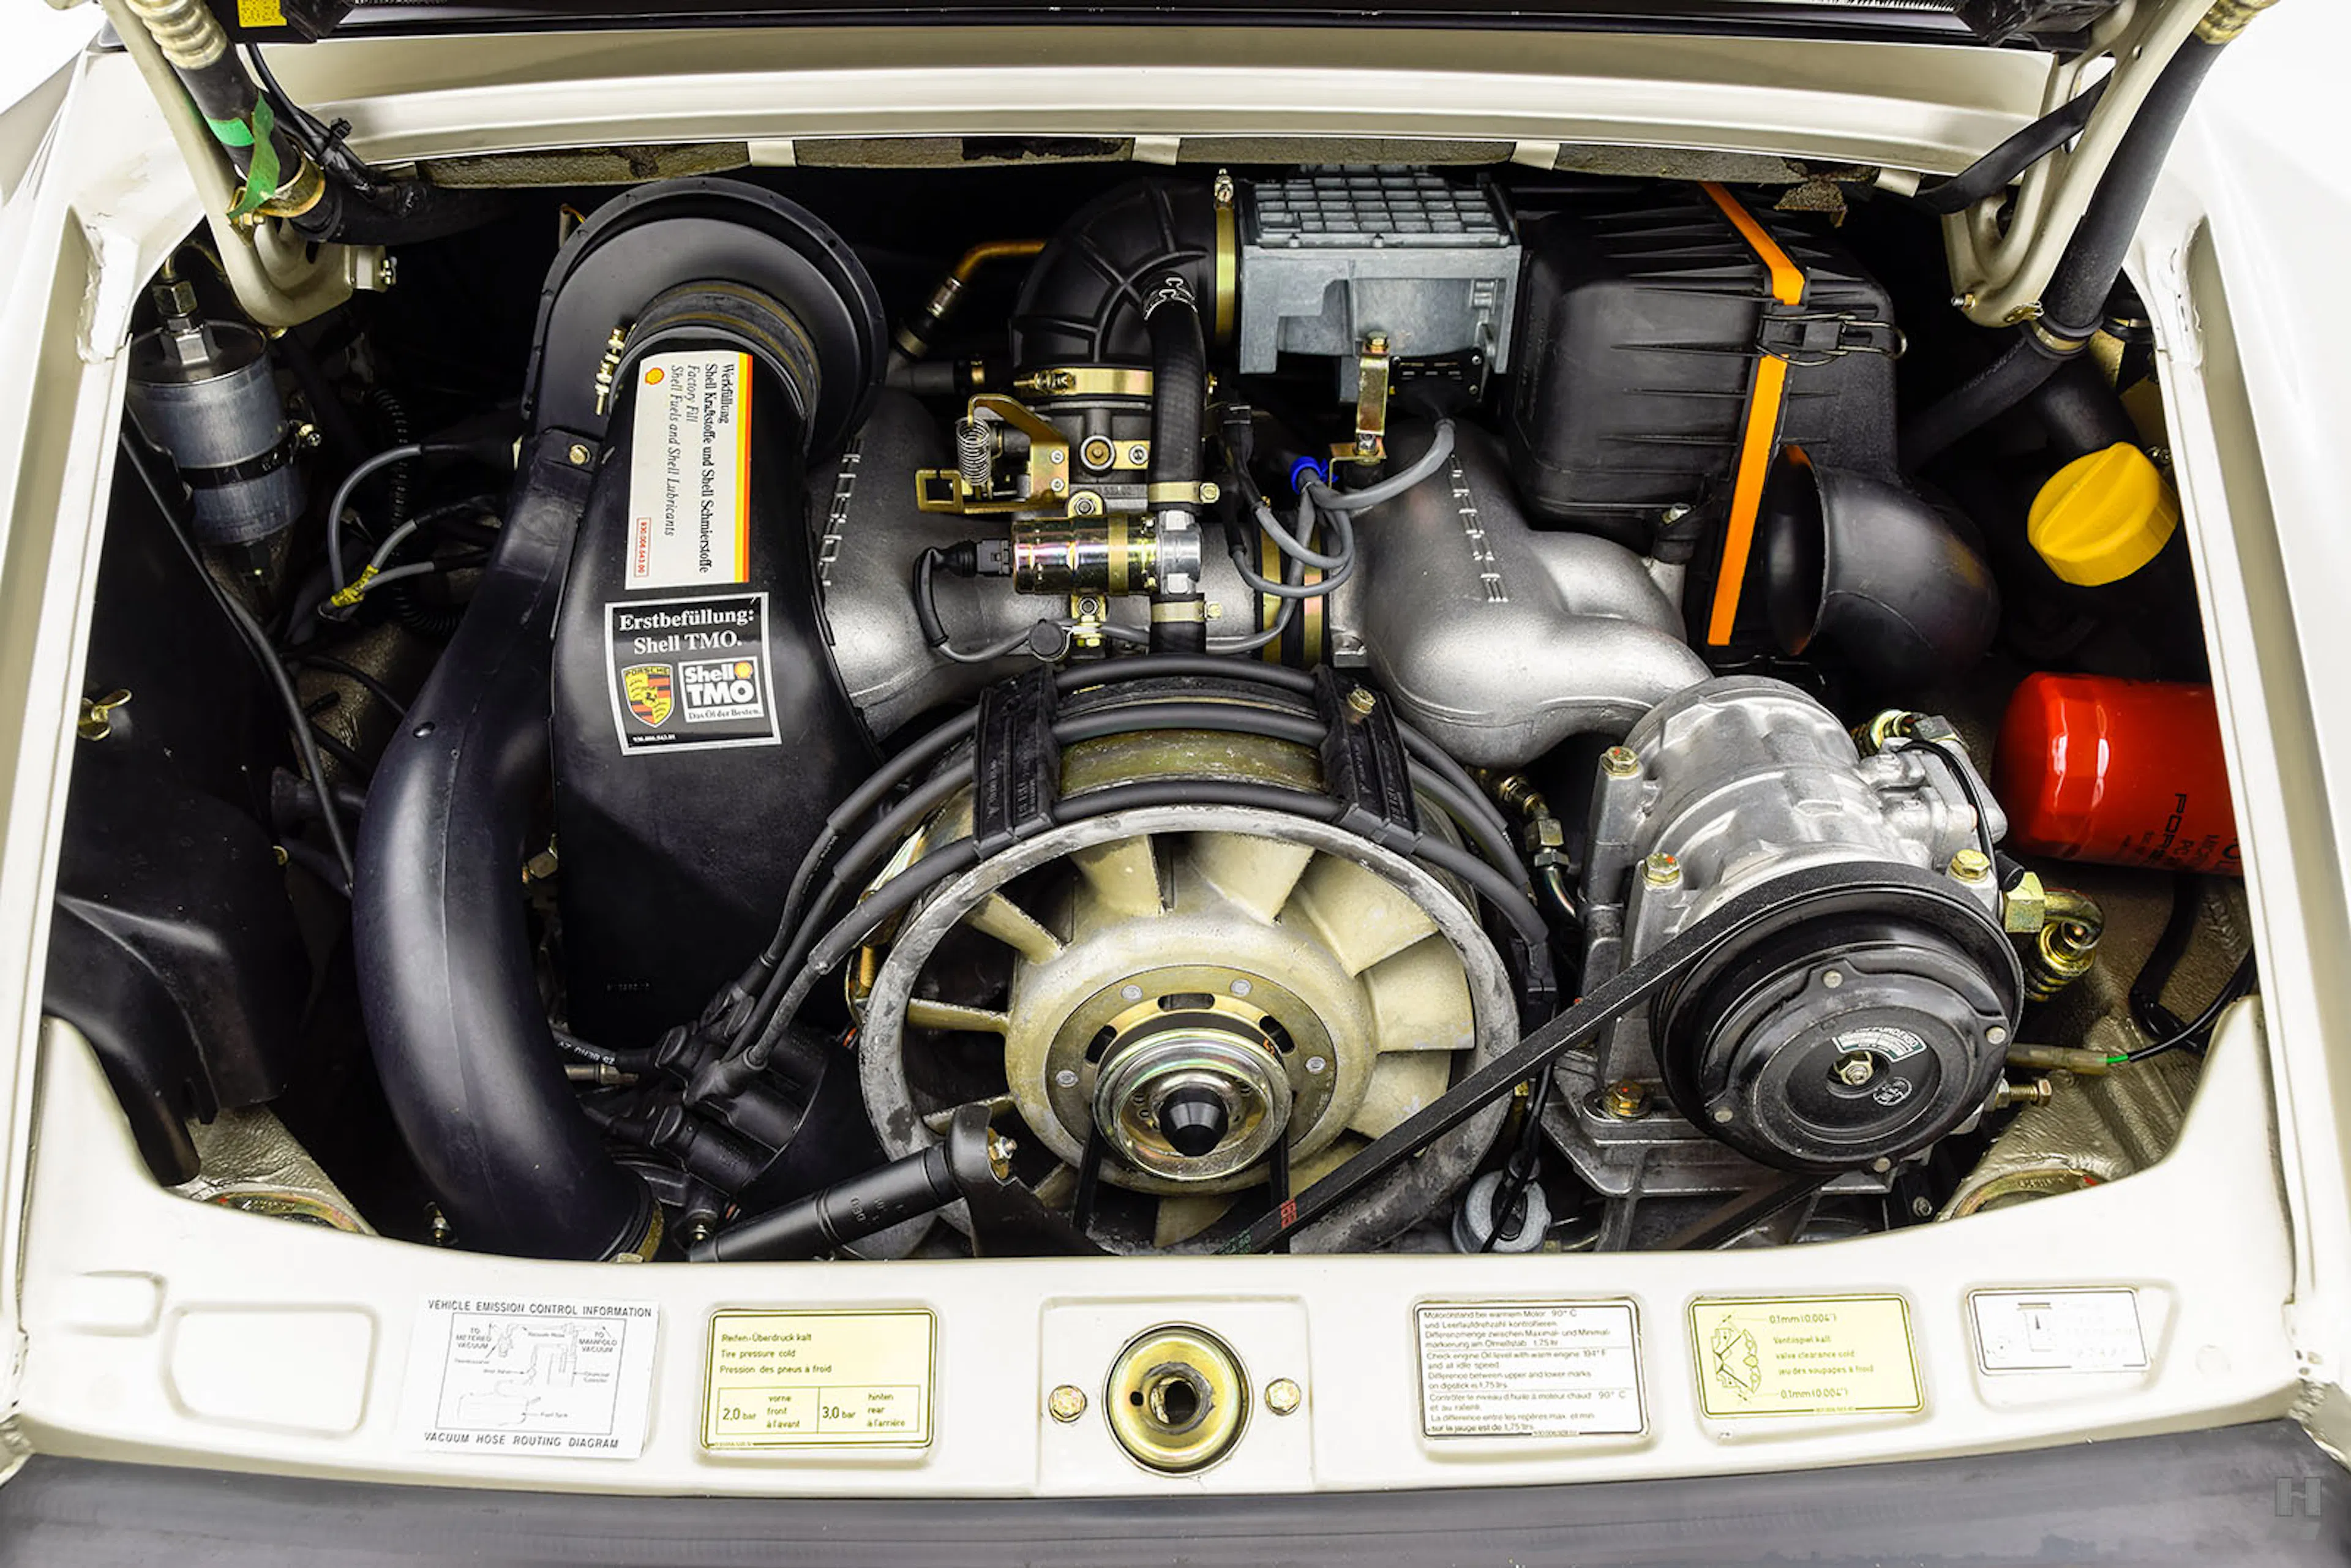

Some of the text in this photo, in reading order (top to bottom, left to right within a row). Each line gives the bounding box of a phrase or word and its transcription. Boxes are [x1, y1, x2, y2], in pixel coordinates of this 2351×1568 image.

[686, 365, 700, 422] Factory Fill
[718, 364, 733, 424] Werkfüllung
[664, 365, 683, 536] Shell Fuels and Shell Lubricants
[699, 364, 718, 573] Shell Kraftstoffe und Shell Schmierstoffe
[619, 609, 755, 631] Erstbefüllung:
[634, 630, 743, 655] Shell TMO.
[684, 664, 735, 683] Shell
[686, 680, 754, 706] TMO
[429, 1299, 651, 1317] VEHICLE EMISSION CONTROL INFORMATION
[797, 1333, 812, 1341] kalt
[721, 1349, 736, 1358] Tire
[719, 1365, 756, 1374] Pression
[759, 1365, 774, 1373] des
[777, 1366, 802, 1375] pneus
[812, 1364, 832, 1373] froid
[822, 1406, 839, 1419] 3,0
[424, 1432, 619, 1449] VACUUM HOSE ROUTING DIAGRAM
